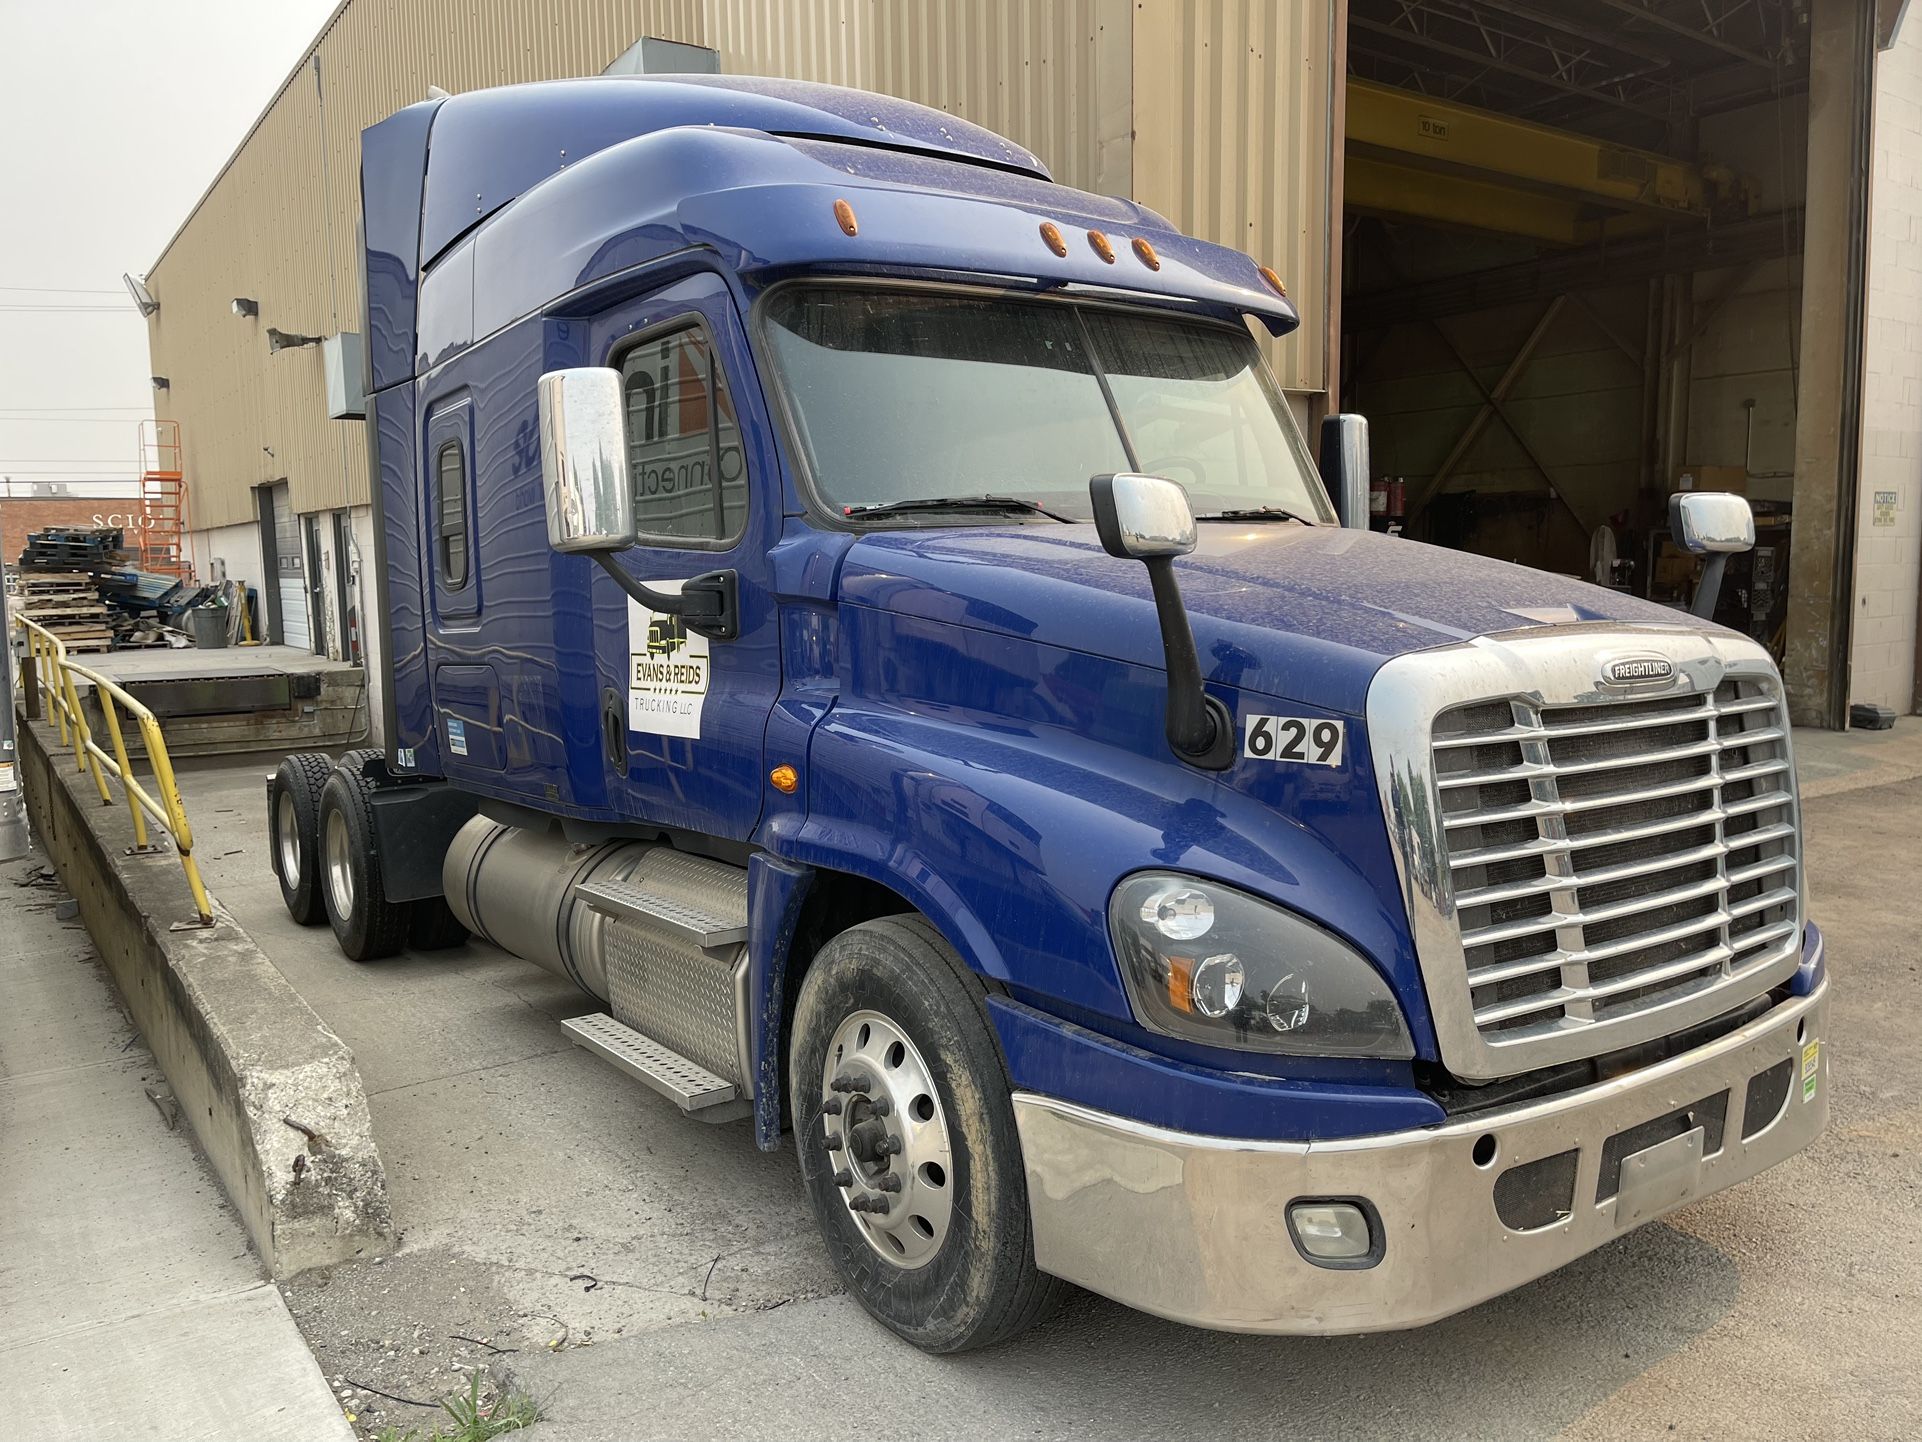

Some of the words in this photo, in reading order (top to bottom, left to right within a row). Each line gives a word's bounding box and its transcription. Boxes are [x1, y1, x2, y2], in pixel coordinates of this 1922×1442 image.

[1421, 121, 1430, 132] 10
[1432, 122, 1446, 136] ton
[1876, 494, 1896, 504] NOTICE
[92, 514, 163, 529] SCIO
[636, 663, 664, 683] EVANS
[665, 664, 673, 682] &
[673, 665, 701, 685] REIDS
[1615, 662, 1670, 678] FREIGHTLINER
[634, 697, 678, 715] TRUCKING
[680, 702, 693, 716] LLC
[1248, 717, 1340, 762] 629
